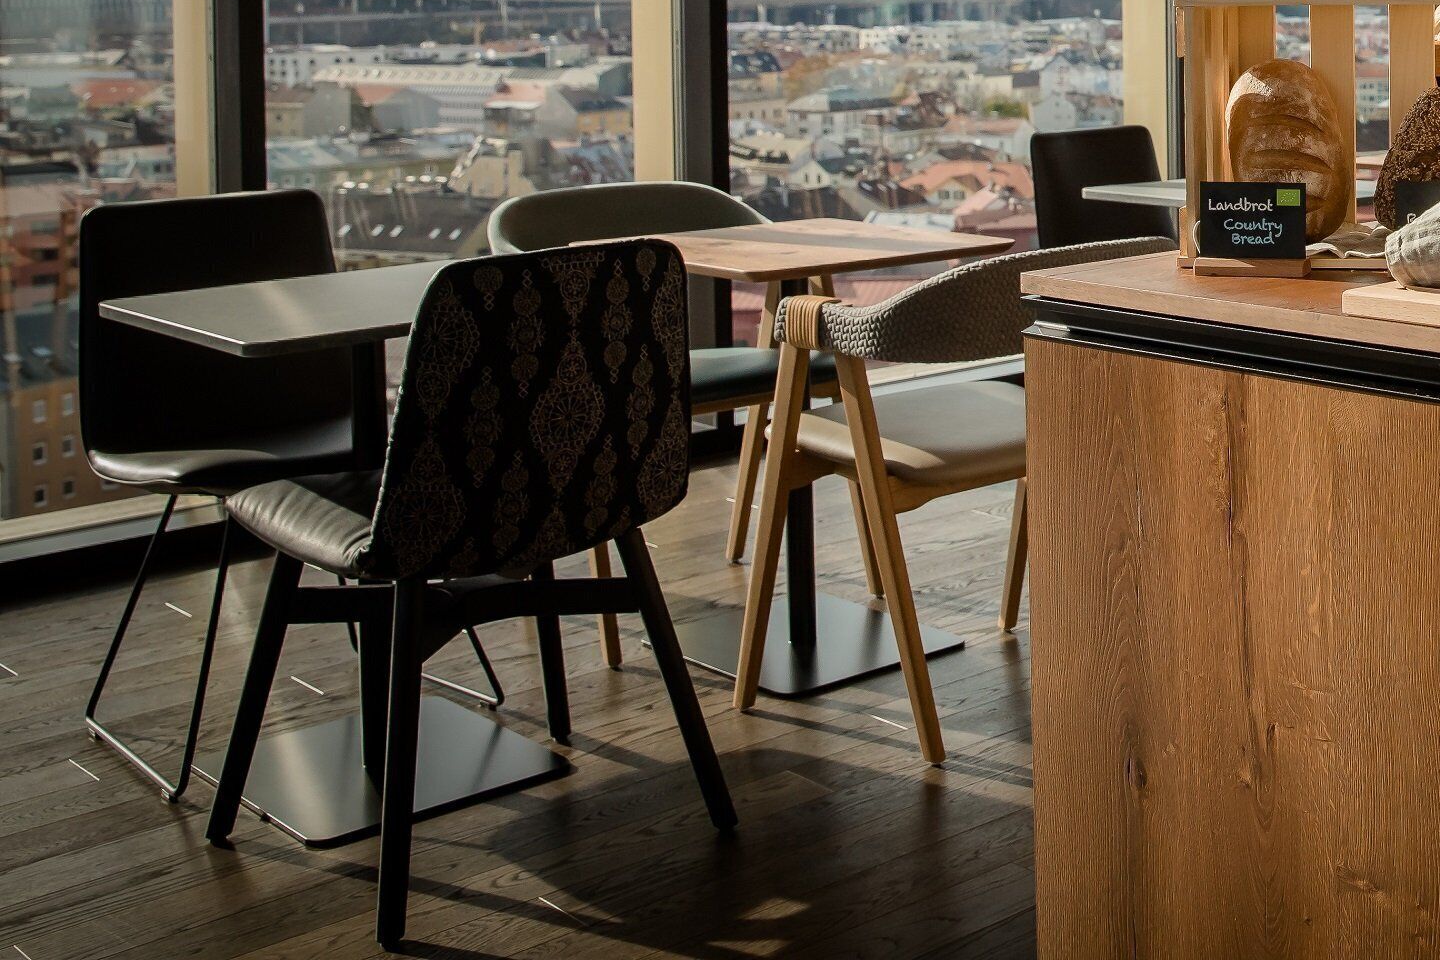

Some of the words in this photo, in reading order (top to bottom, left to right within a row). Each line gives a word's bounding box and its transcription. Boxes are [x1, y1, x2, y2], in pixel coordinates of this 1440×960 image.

[1208, 196, 1274, 212] Landbrot
[1223, 217, 1283, 238] Country
[1231, 231, 1275, 245] Bread
